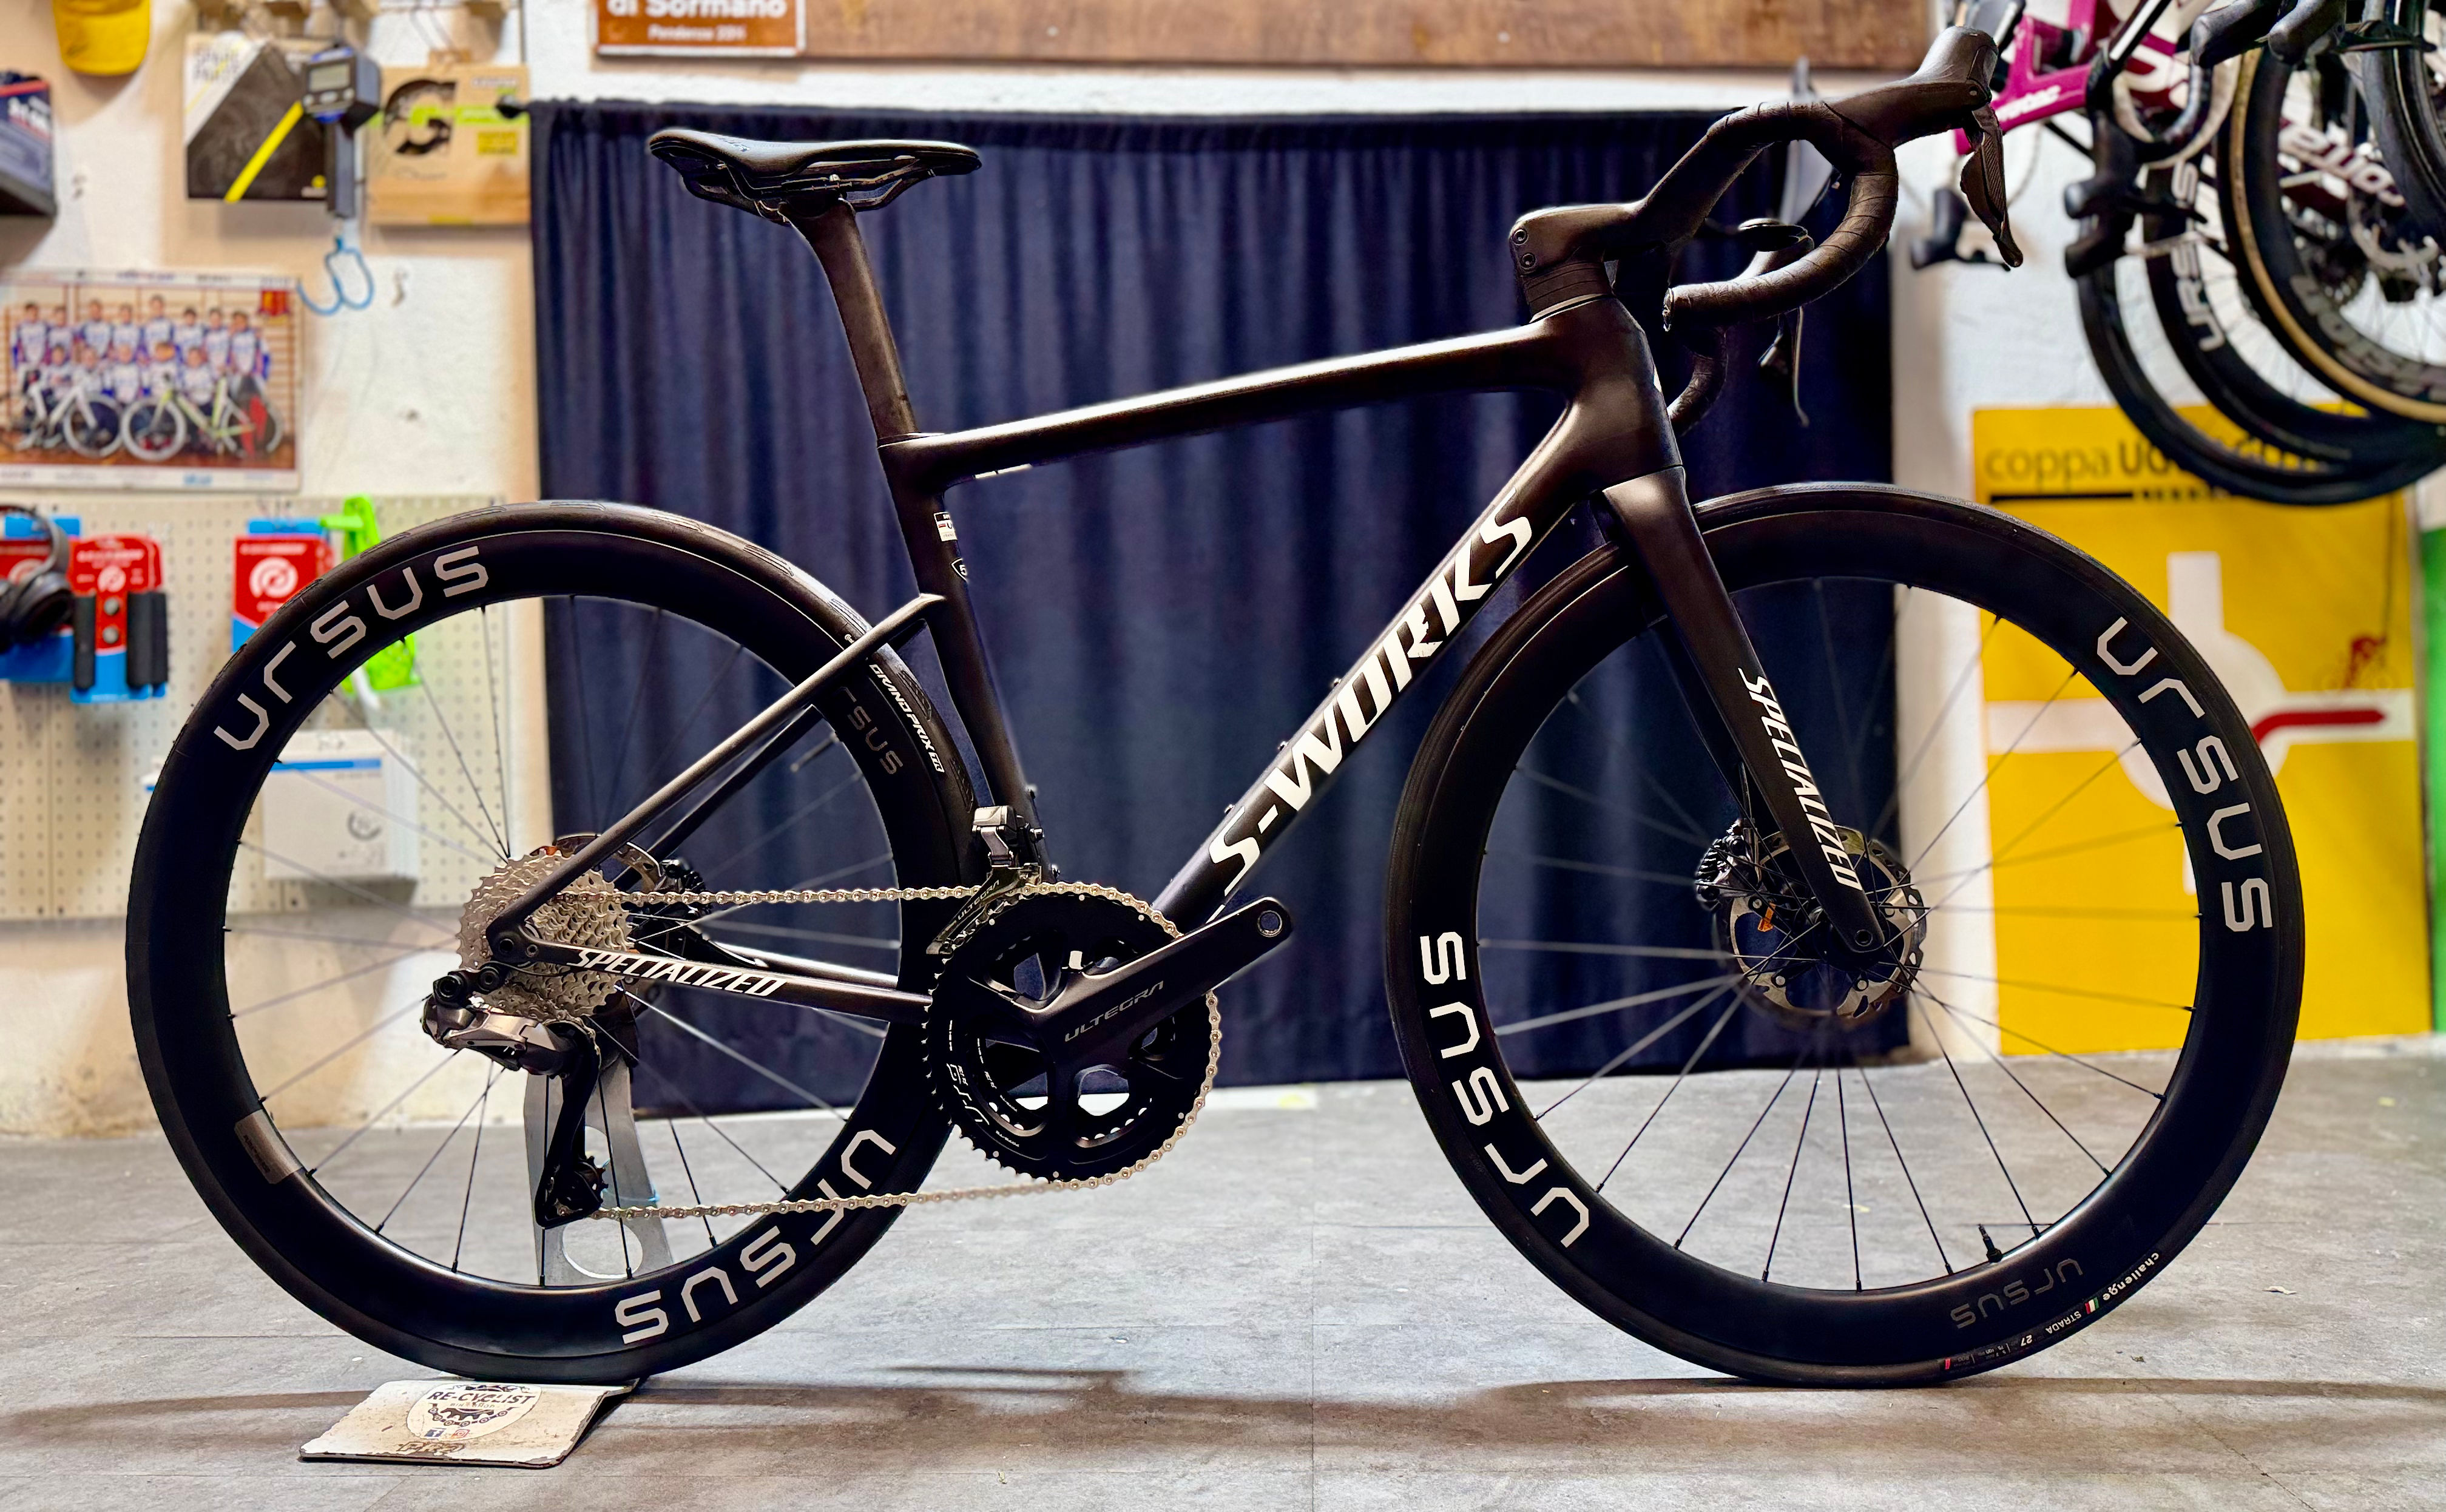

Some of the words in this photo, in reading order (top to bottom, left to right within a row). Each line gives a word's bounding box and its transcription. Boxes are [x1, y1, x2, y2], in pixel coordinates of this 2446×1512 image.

[644, 0, 788, 19] Sormano
[1982, 446, 2112, 492] coppa
[869, 664, 913, 713] GRAND
[907, 714, 935, 751] PRIX
[1208, 487, 1532, 897] S-WORKS
[1737, 667, 1863, 891] SPECIALIZED
[566, 949, 788, 997] SPECIALIZED
[1064, 980, 1164, 1042] ULTEGRA
[2102, 1252, 2160, 1301] challenge
[2020, 1334, 2033, 1347] 27
[2045, 1310, 2083, 1335] STRADA
[426, 1391, 535, 1405] RE-CYCLIST
